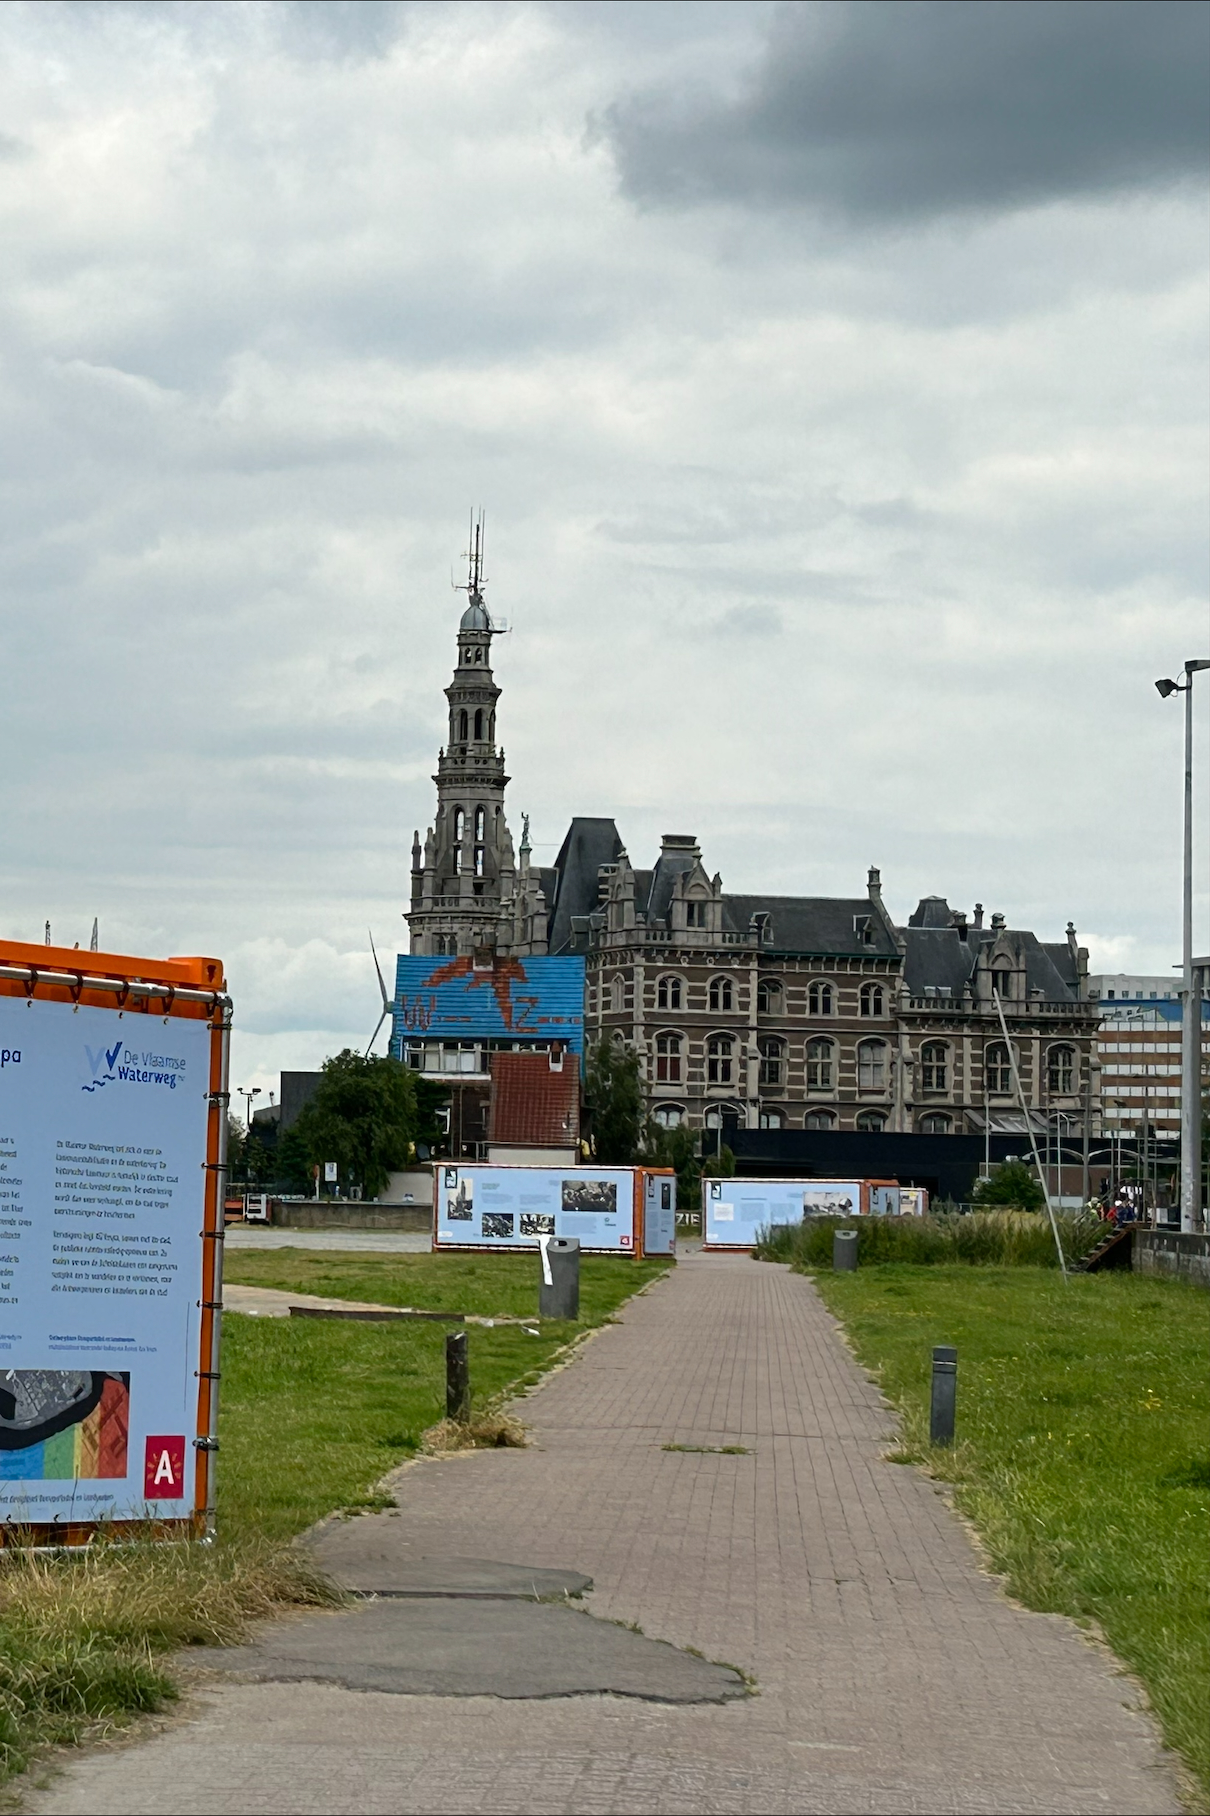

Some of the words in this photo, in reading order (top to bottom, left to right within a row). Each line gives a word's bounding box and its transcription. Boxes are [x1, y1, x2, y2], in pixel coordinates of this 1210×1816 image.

[124, 1050, 138, 1065] De
[142, 1052, 186, 1070] Vlaamse
[118, 1066, 177, 1089] Waterweg
[154, 1450, 174, 1484] A
